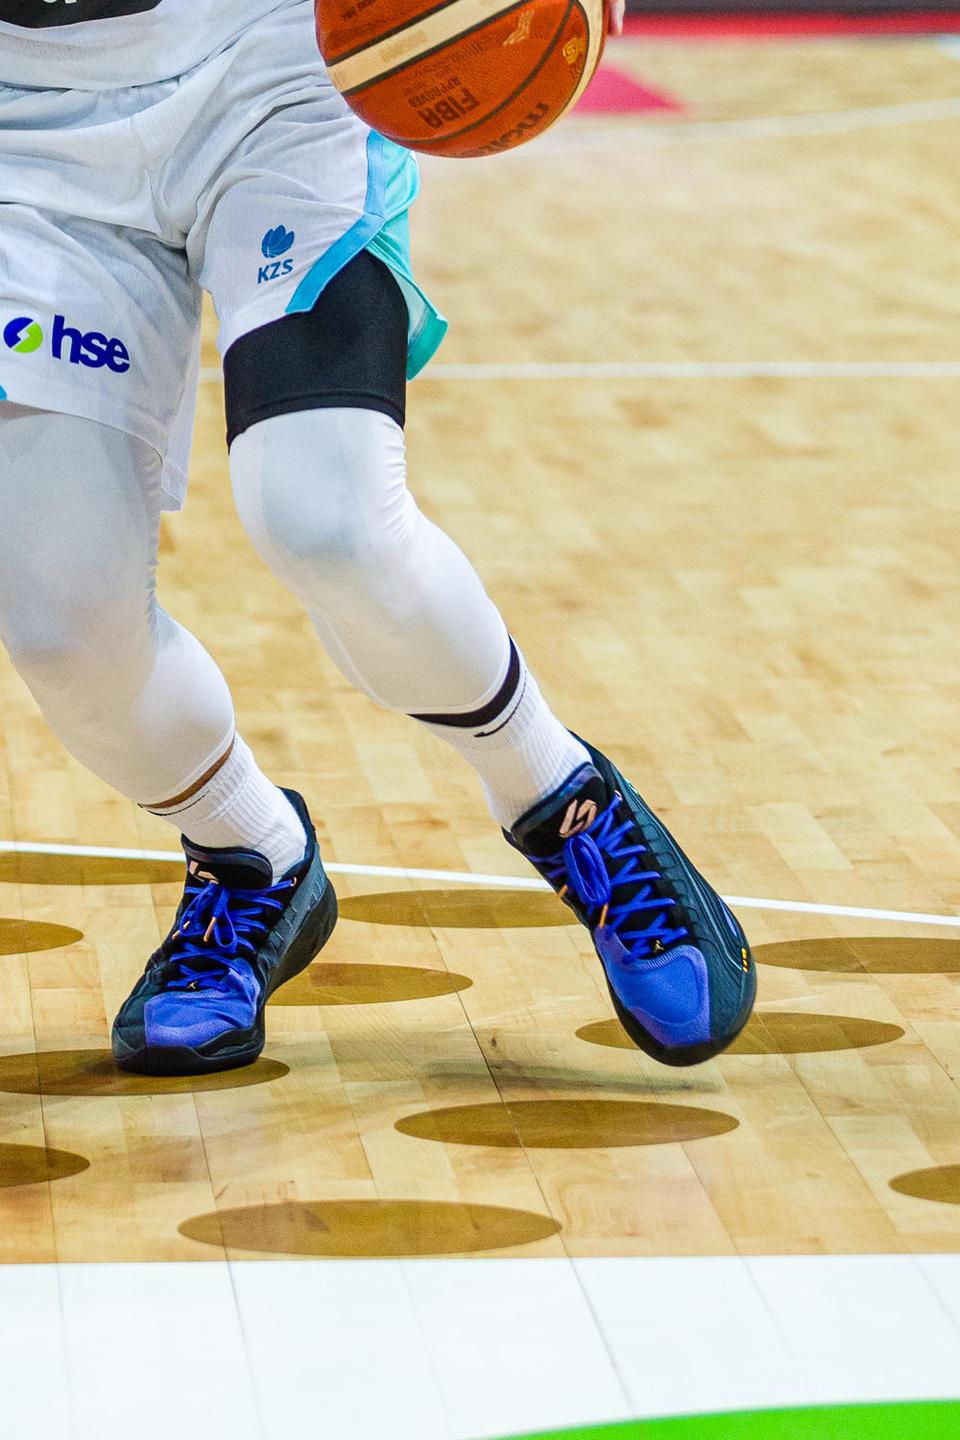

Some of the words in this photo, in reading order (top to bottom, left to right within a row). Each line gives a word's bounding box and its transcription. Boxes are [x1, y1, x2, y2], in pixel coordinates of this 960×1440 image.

[419, 88, 481, 129] FIBA
[257, 258, 294, 284] KZS
[51, 314, 131, 373] hse
